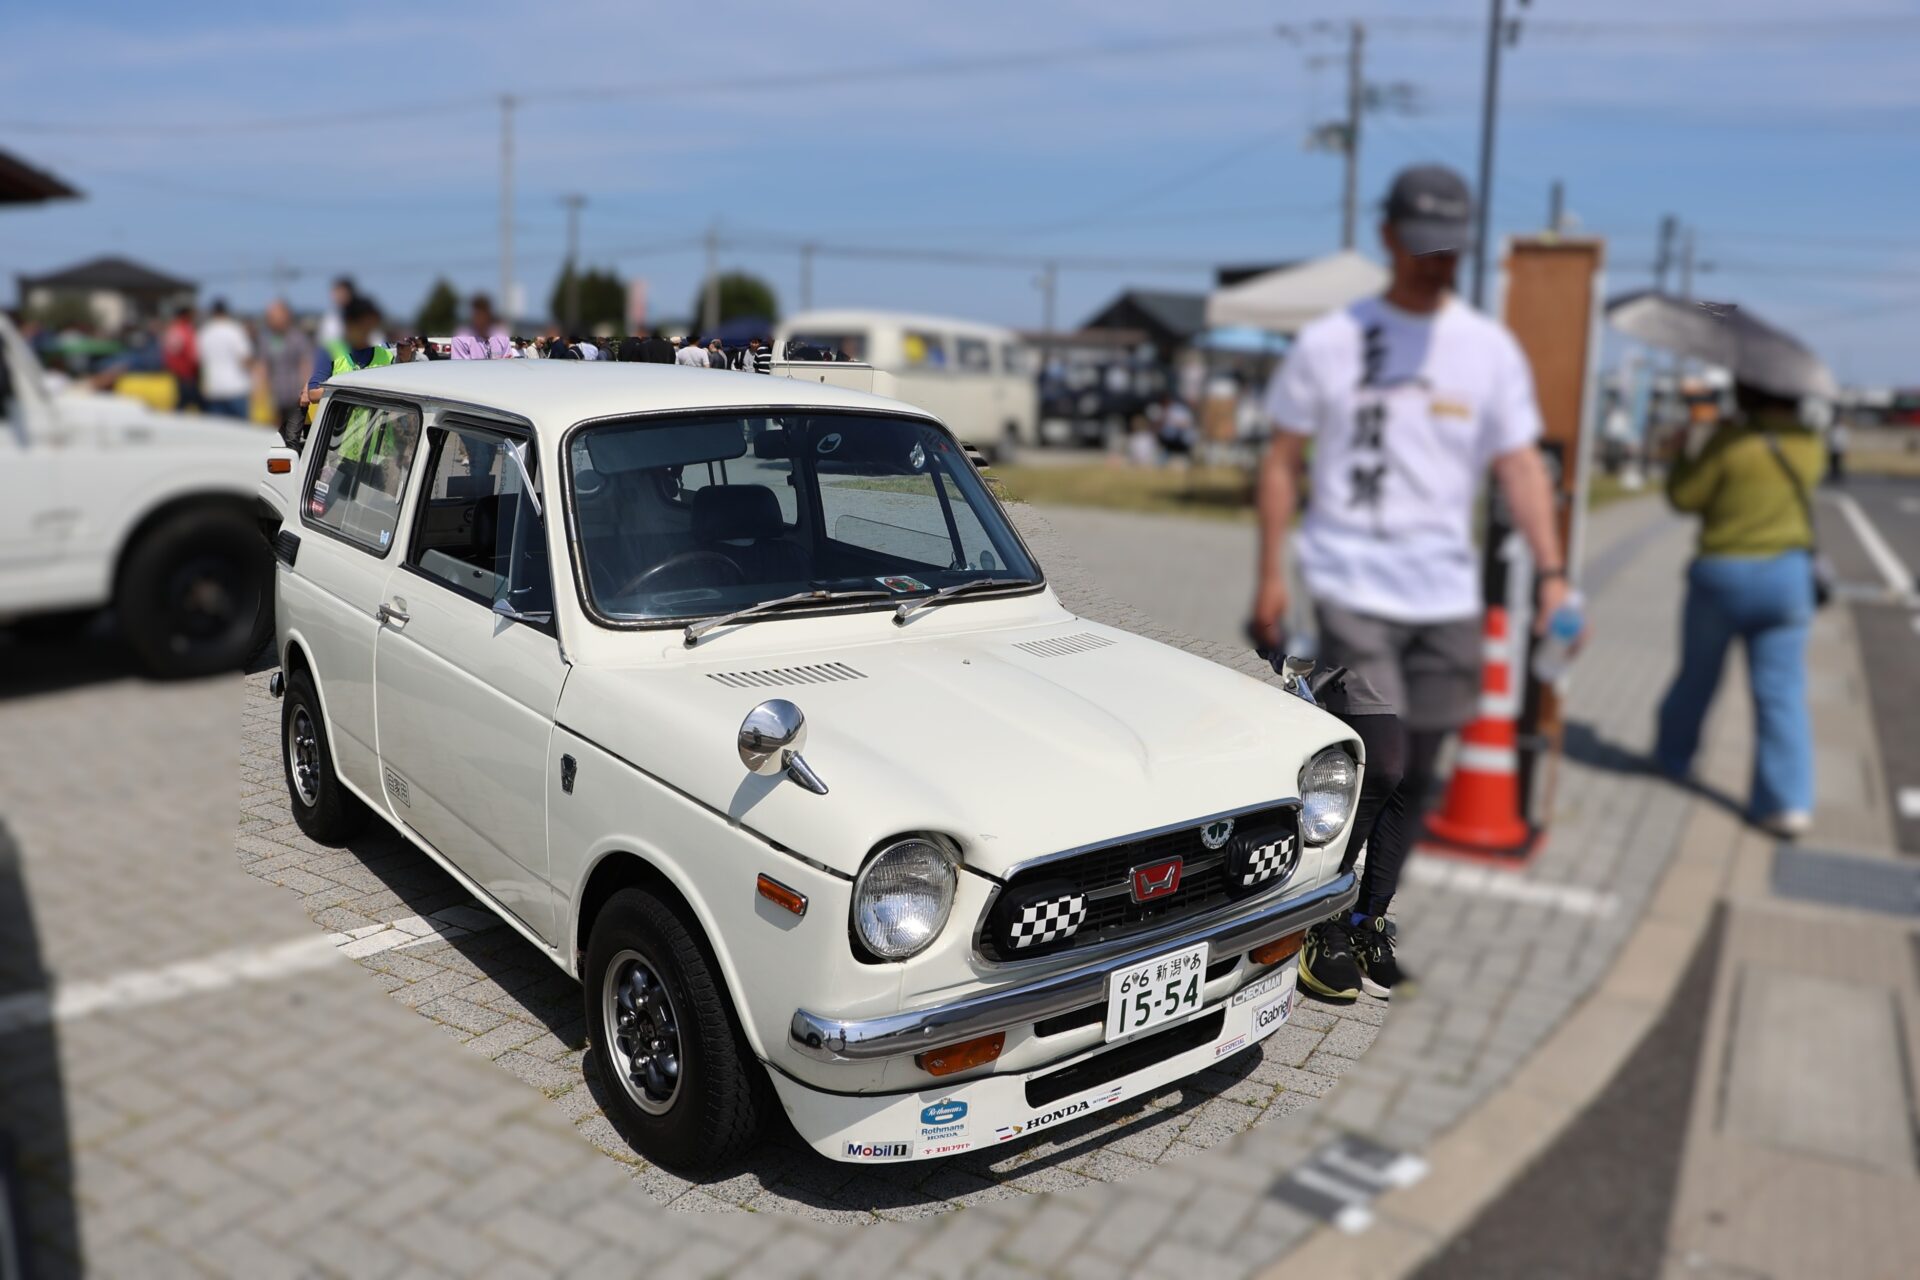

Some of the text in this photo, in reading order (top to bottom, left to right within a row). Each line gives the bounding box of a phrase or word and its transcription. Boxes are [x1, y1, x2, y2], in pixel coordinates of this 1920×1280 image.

[1156, 958, 1182, 982] 新潟
[1190, 952, 1201, 970] あ
[1119, 973, 1198, 1033] 15-54
[1233, 974, 1281, 1005] CHECKMAN
[921, 1124, 965, 1135] Rothmans
[1026, 1100, 1090, 1130] HONDA
[847, 1143, 907, 1156] Mobil 1
[927, 1132, 958, 1140] HONDA
